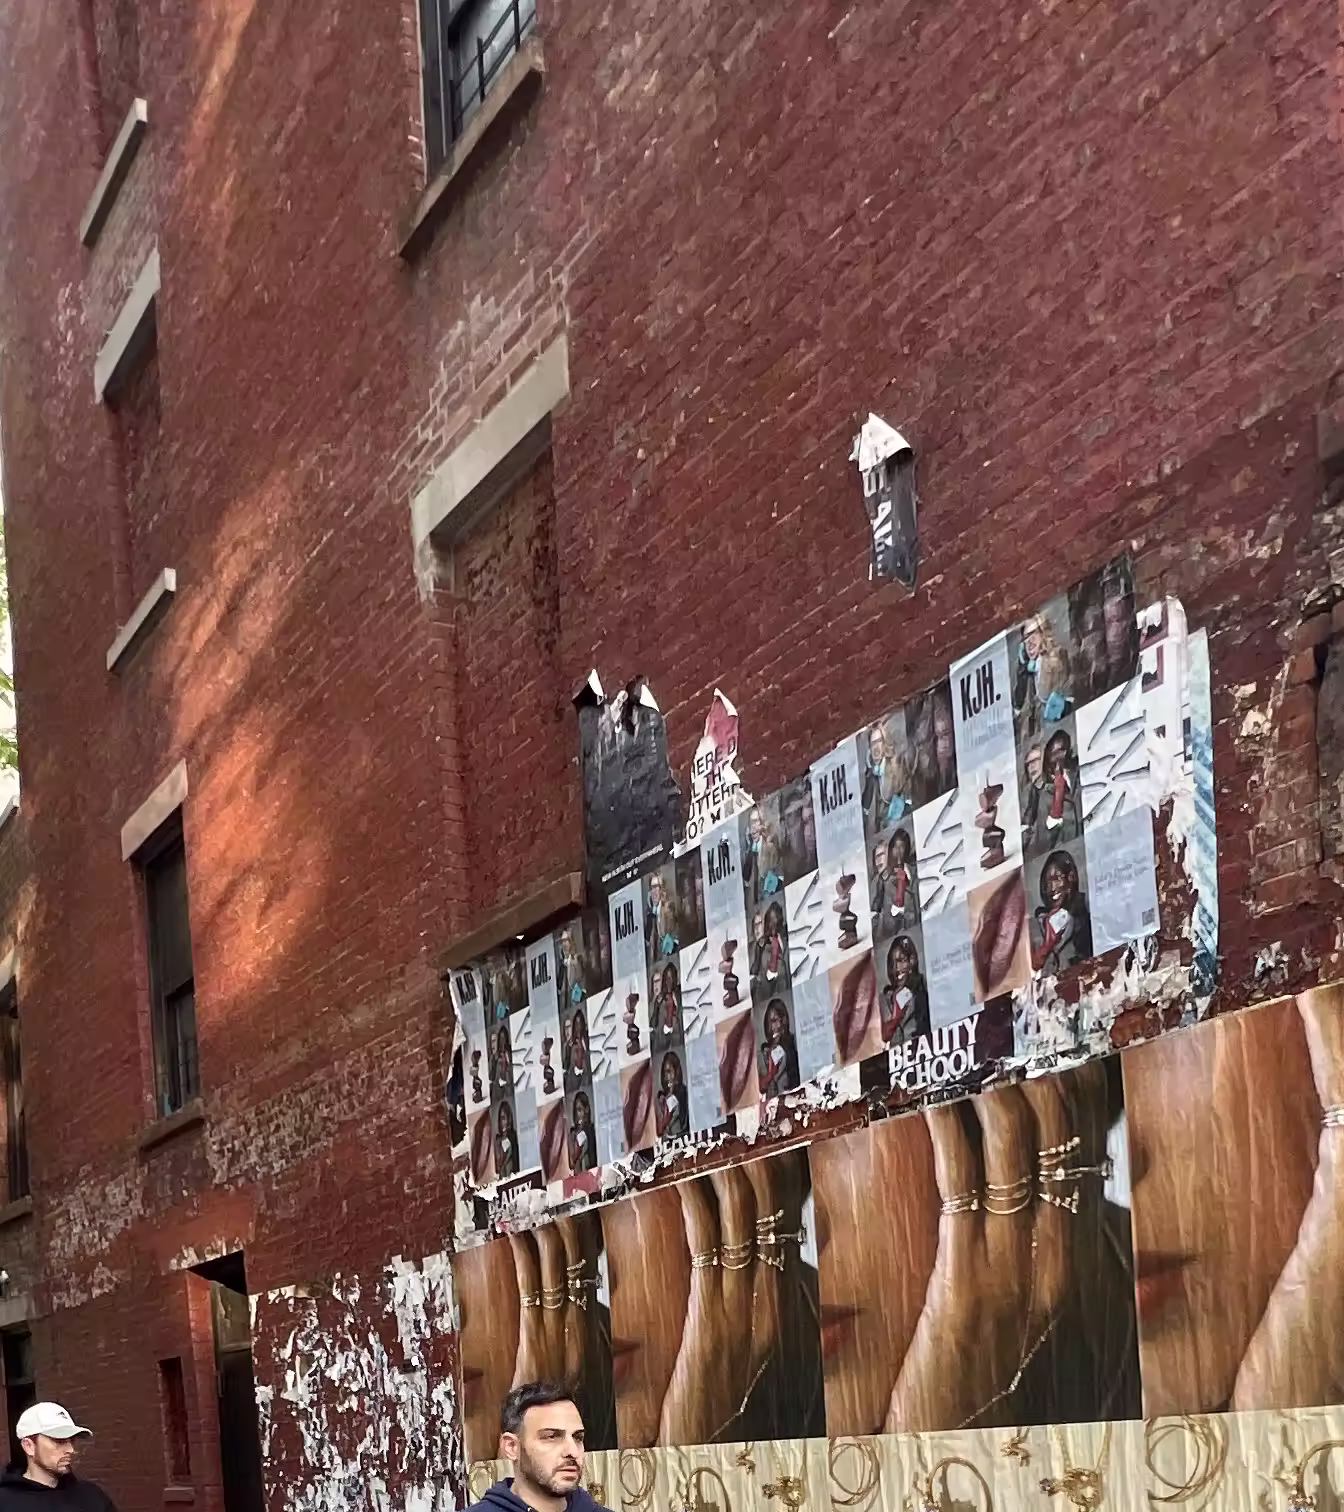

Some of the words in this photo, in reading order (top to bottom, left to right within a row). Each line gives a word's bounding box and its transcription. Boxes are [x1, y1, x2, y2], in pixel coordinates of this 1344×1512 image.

[960, 660, 1002, 721] KJH.
[819, 764, 854, 816] KJH.
[614, 899, 639, 941] KJH.
[889, 1013, 980, 1074] BEAUTY
[889, 1044, 981, 1094] SCHOOL
